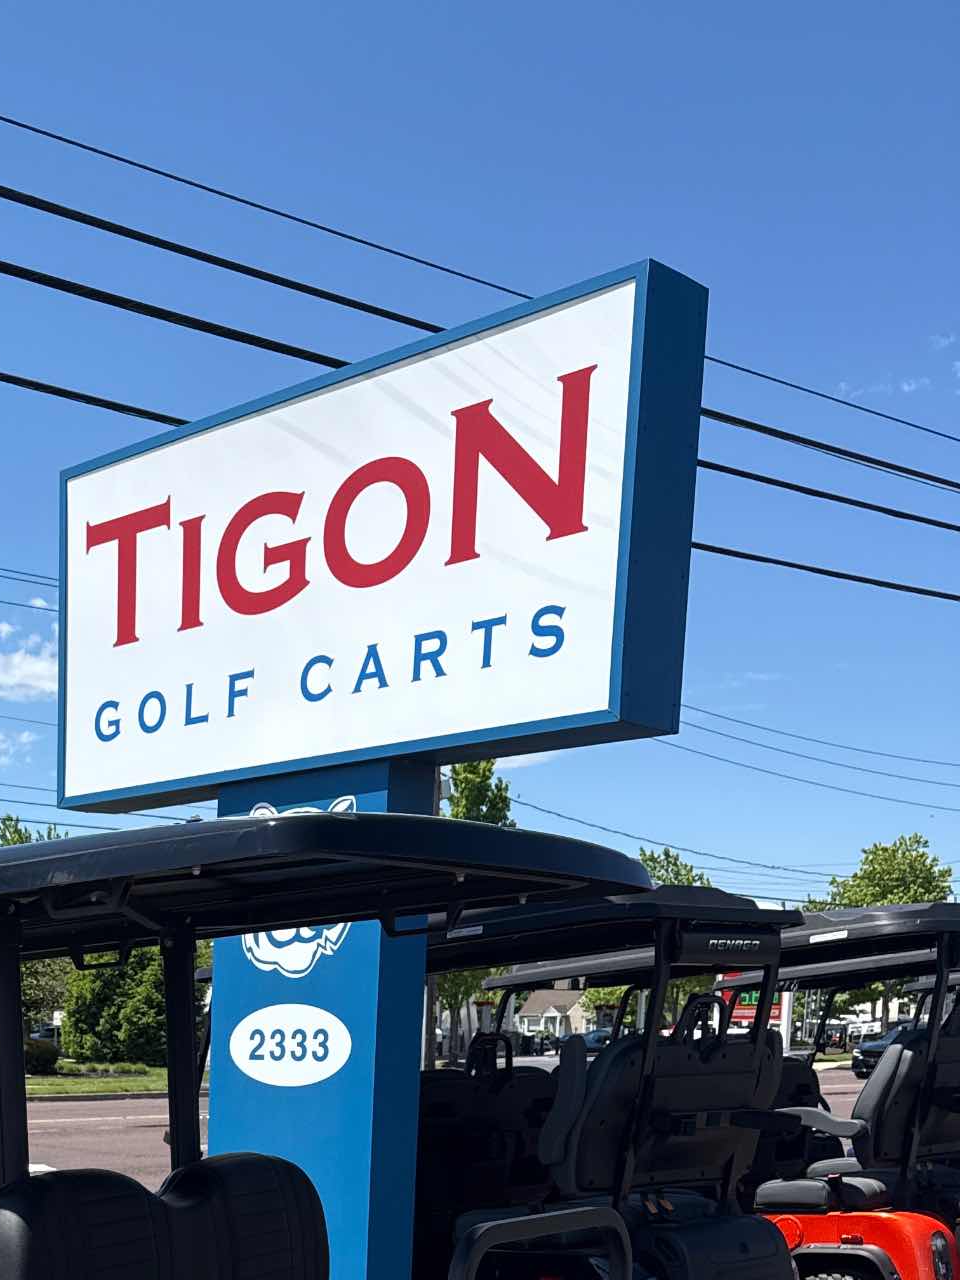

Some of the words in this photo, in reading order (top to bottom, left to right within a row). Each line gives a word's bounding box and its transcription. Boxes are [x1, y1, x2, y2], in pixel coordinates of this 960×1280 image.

[86, 364, 598, 648] TIGON
[95, 669, 254, 743] GOLF
[300, 605, 567, 703] CARTS
[248, 1028, 330, 1062] 2333
